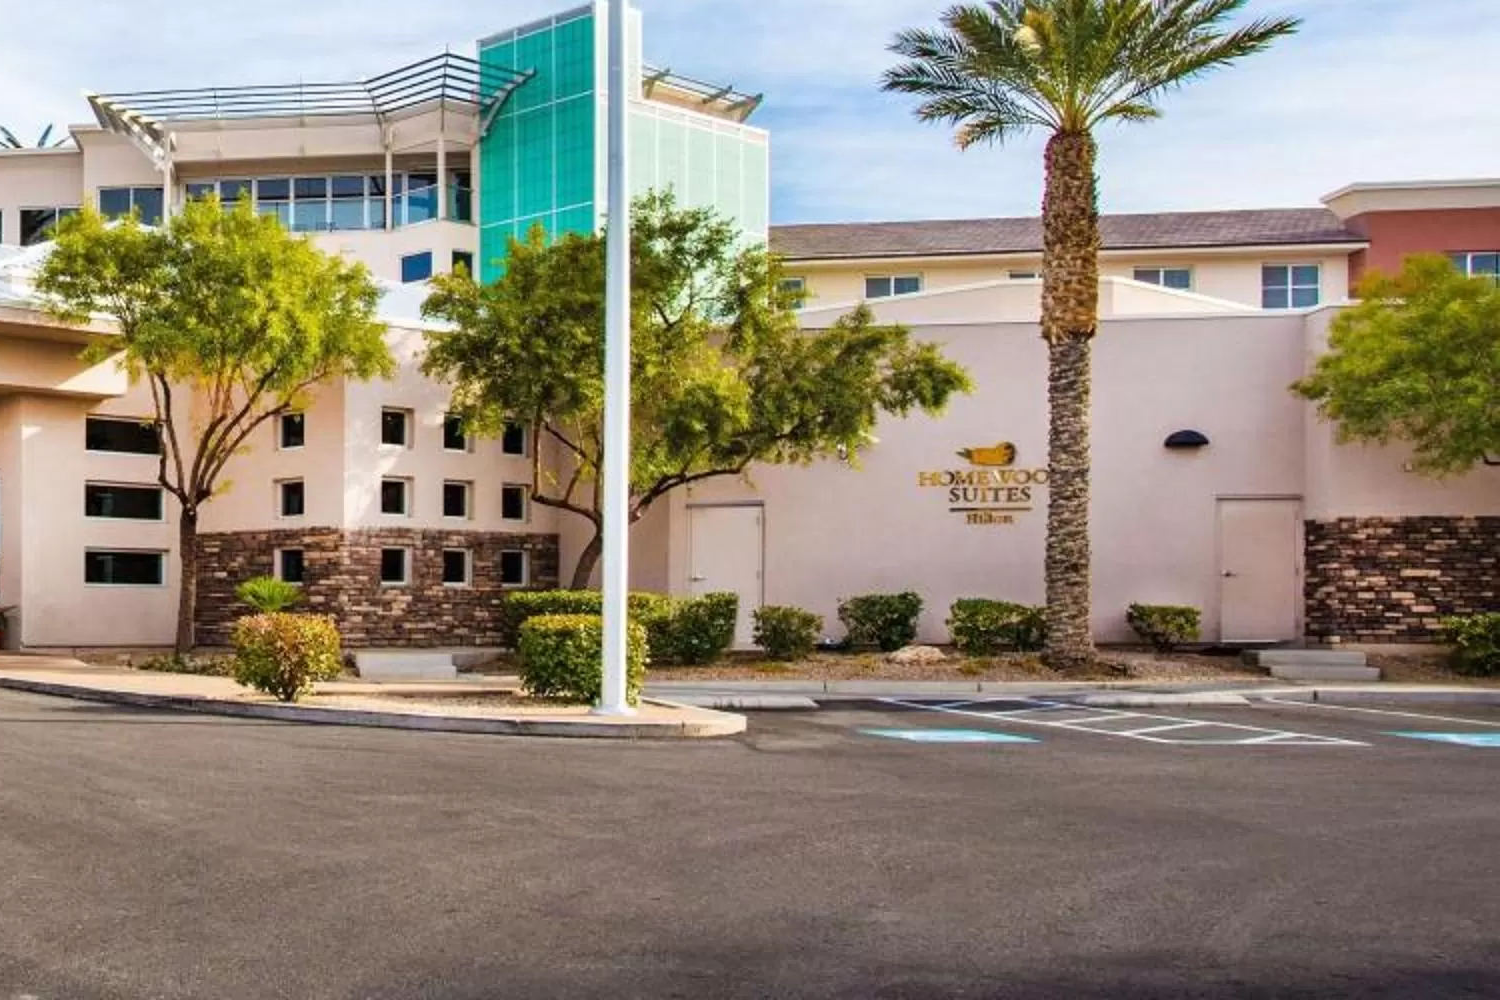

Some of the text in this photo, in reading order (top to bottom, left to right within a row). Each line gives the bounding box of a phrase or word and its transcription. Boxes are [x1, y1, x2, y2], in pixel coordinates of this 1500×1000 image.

[917, 469, 1049, 486] HOMEWOO
[949, 486, 1031, 503] SUITES
[966, 512, 1014, 525] Hilton
